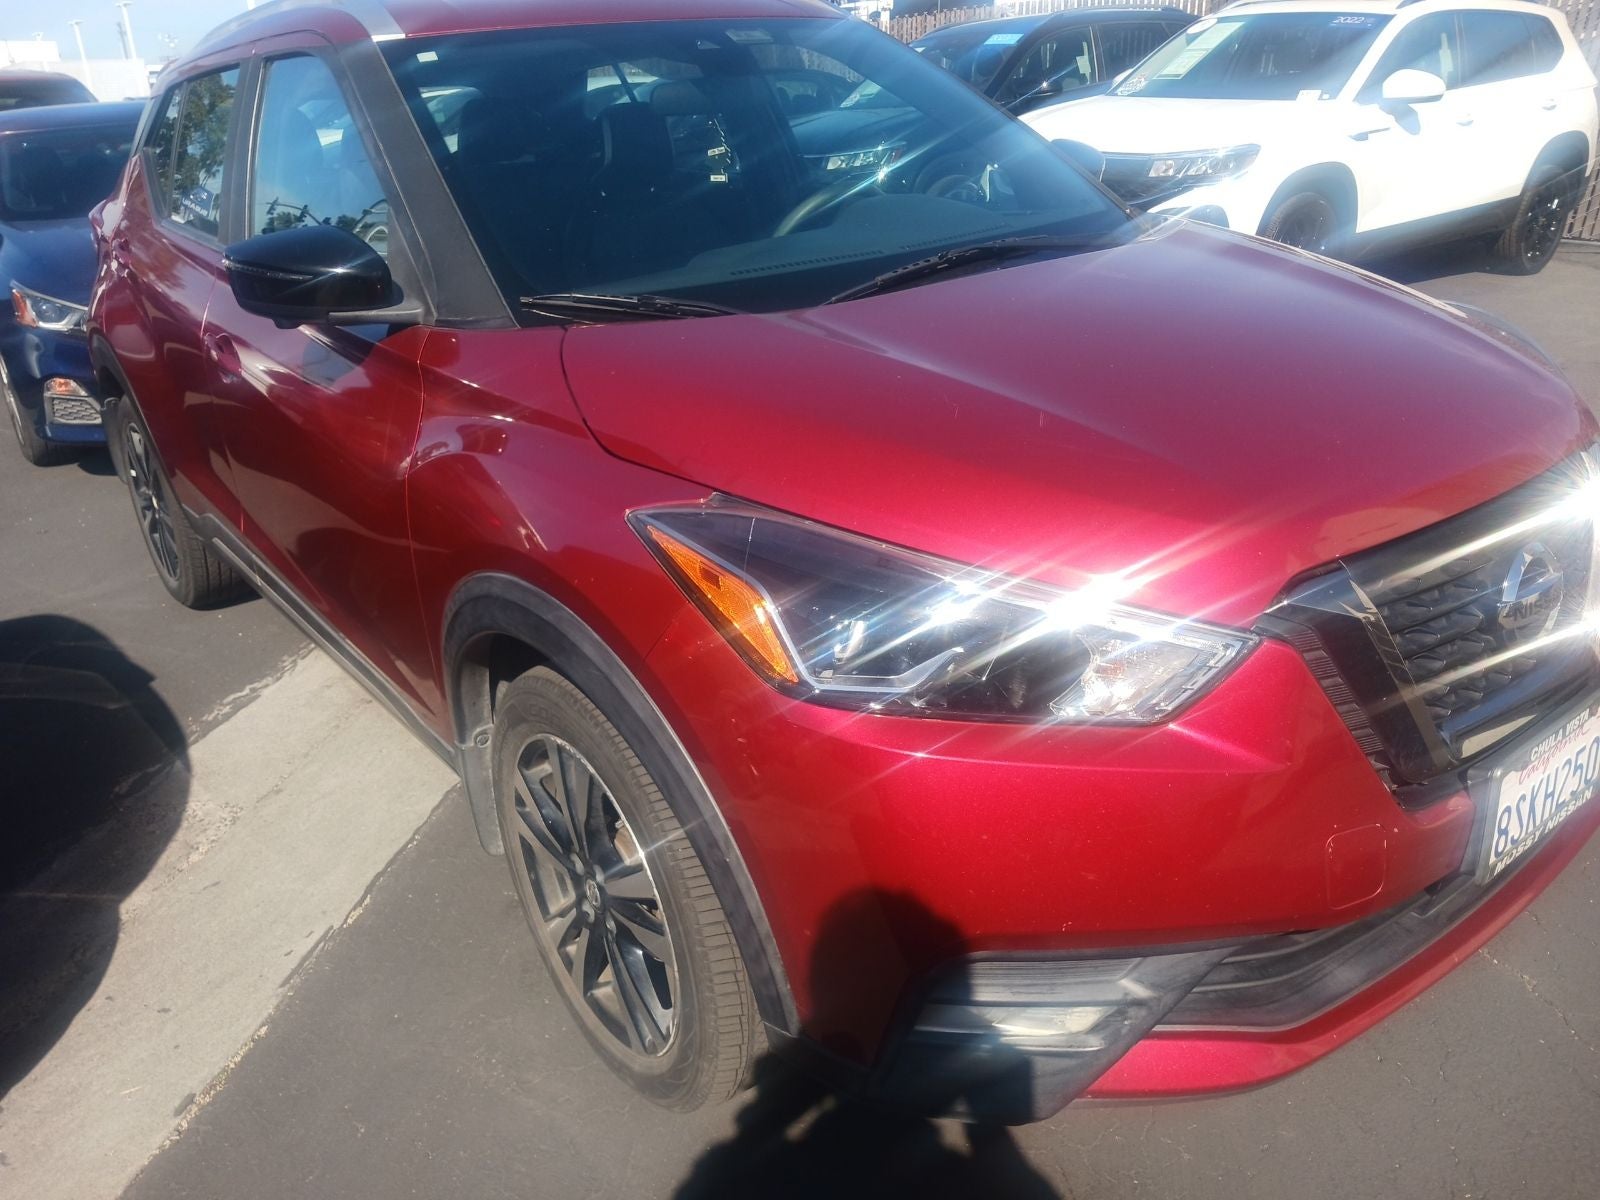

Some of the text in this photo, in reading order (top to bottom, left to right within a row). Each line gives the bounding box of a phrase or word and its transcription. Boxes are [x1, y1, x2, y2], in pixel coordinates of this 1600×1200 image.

[1332, 16, 1365, 24] 2022
[1530, 707, 1591, 762] CHULA VISTA
[1493, 735, 1600, 859] 8SKH250
[1493, 785, 1594, 877] MOSSY NISSAN
